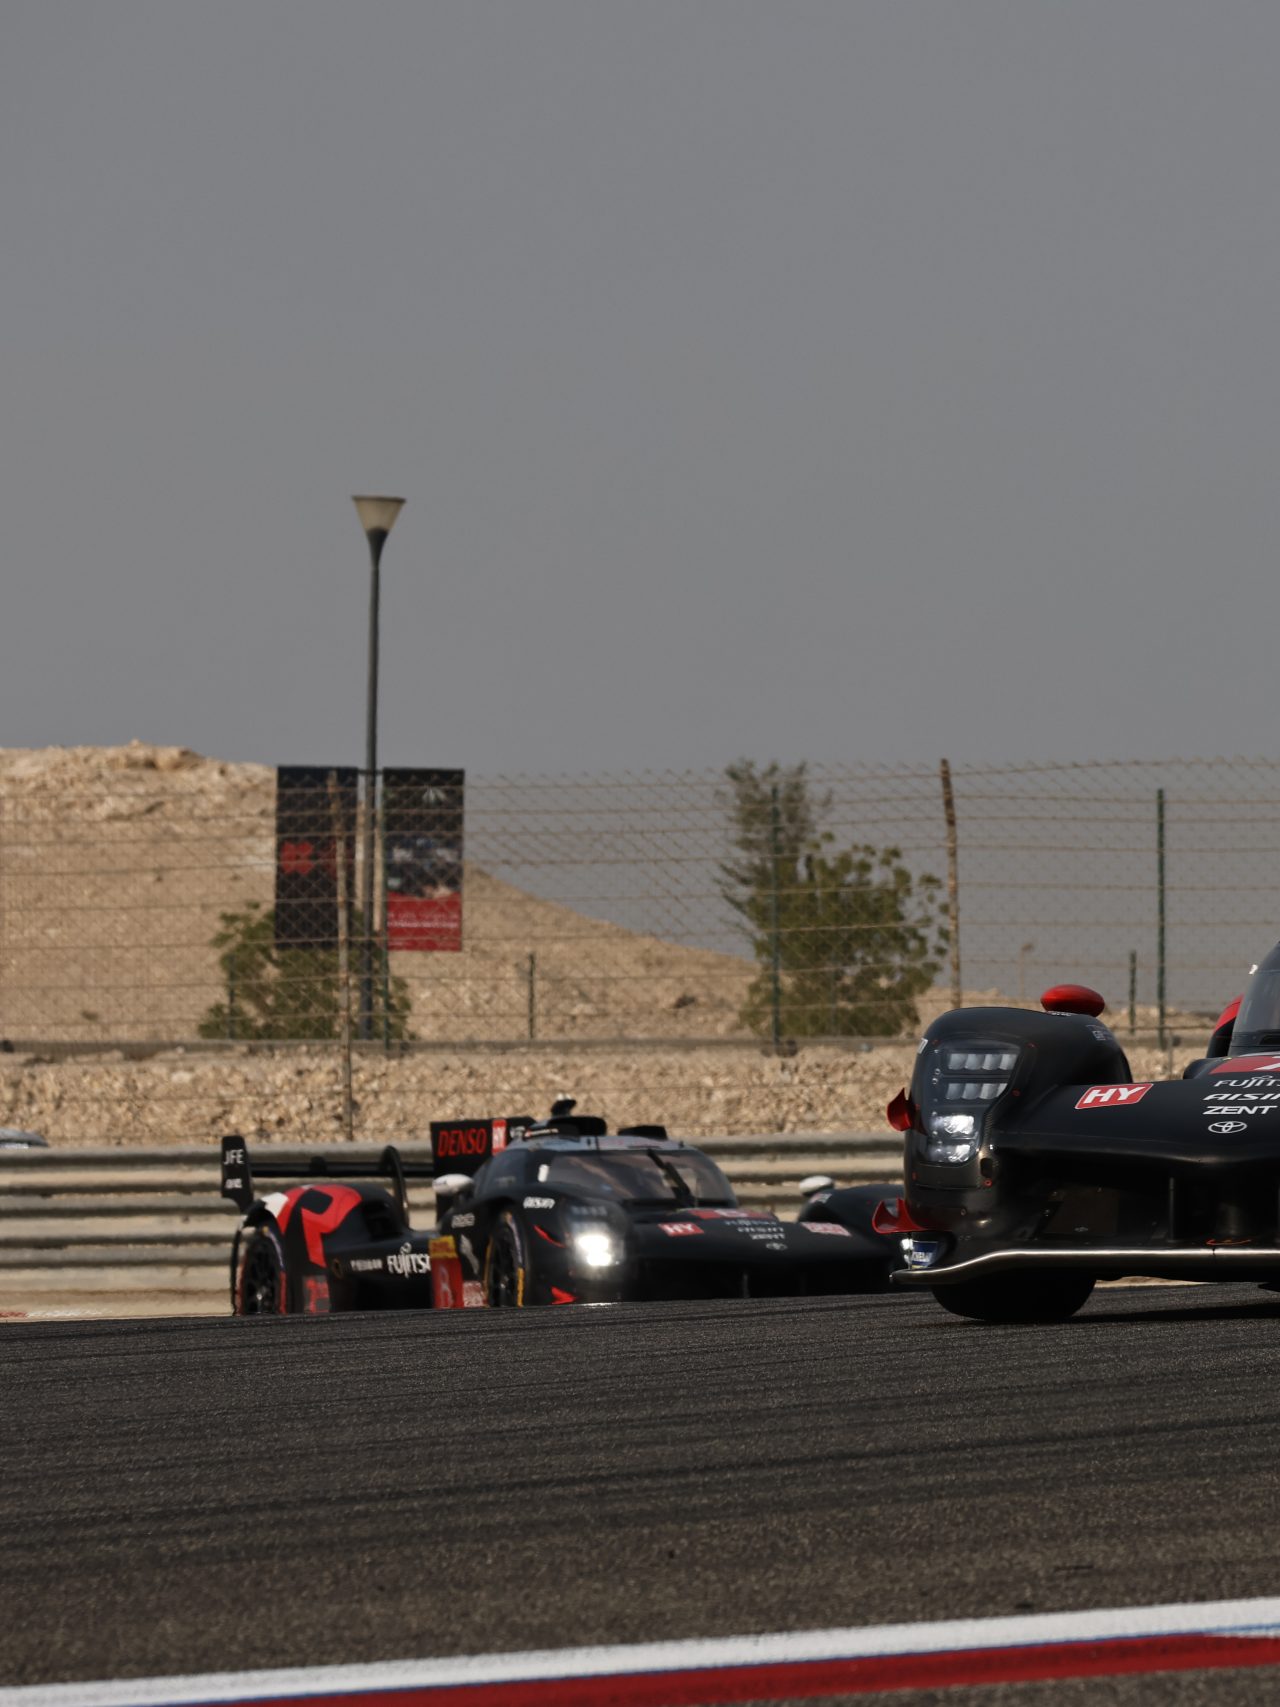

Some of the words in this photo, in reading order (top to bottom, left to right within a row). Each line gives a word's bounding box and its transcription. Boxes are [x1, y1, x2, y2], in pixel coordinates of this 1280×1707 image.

[1083, 1086, 1146, 1104] HY
[1203, 1105, 1278, 1115] ZENT
[437, 1127, 488, 1158] DENSO
[223, 1149, 244, 1165] JFE
[663, 1222, 697, 1235] HY
